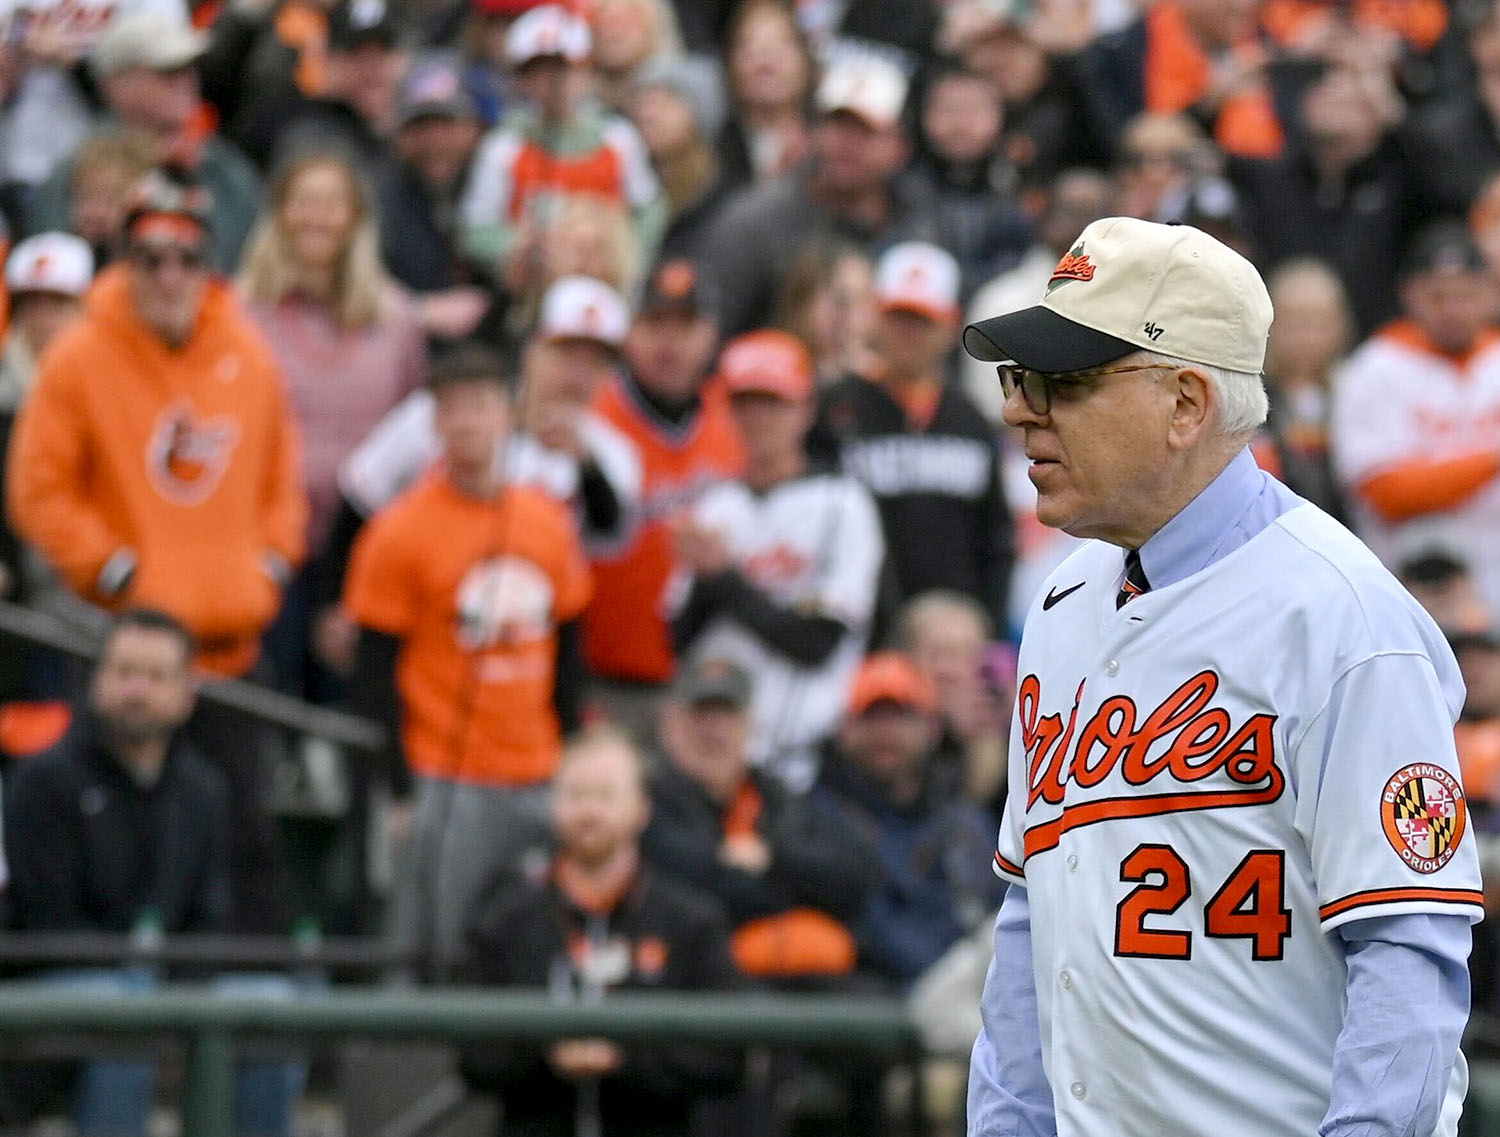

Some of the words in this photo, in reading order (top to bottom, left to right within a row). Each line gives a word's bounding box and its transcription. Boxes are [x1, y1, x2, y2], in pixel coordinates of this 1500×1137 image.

[1383, 764, 1463, 804] BALTIMORE
[1401, 846, 1454, 872] ORIOLES
[1114, 842, 1292, 961] 24
